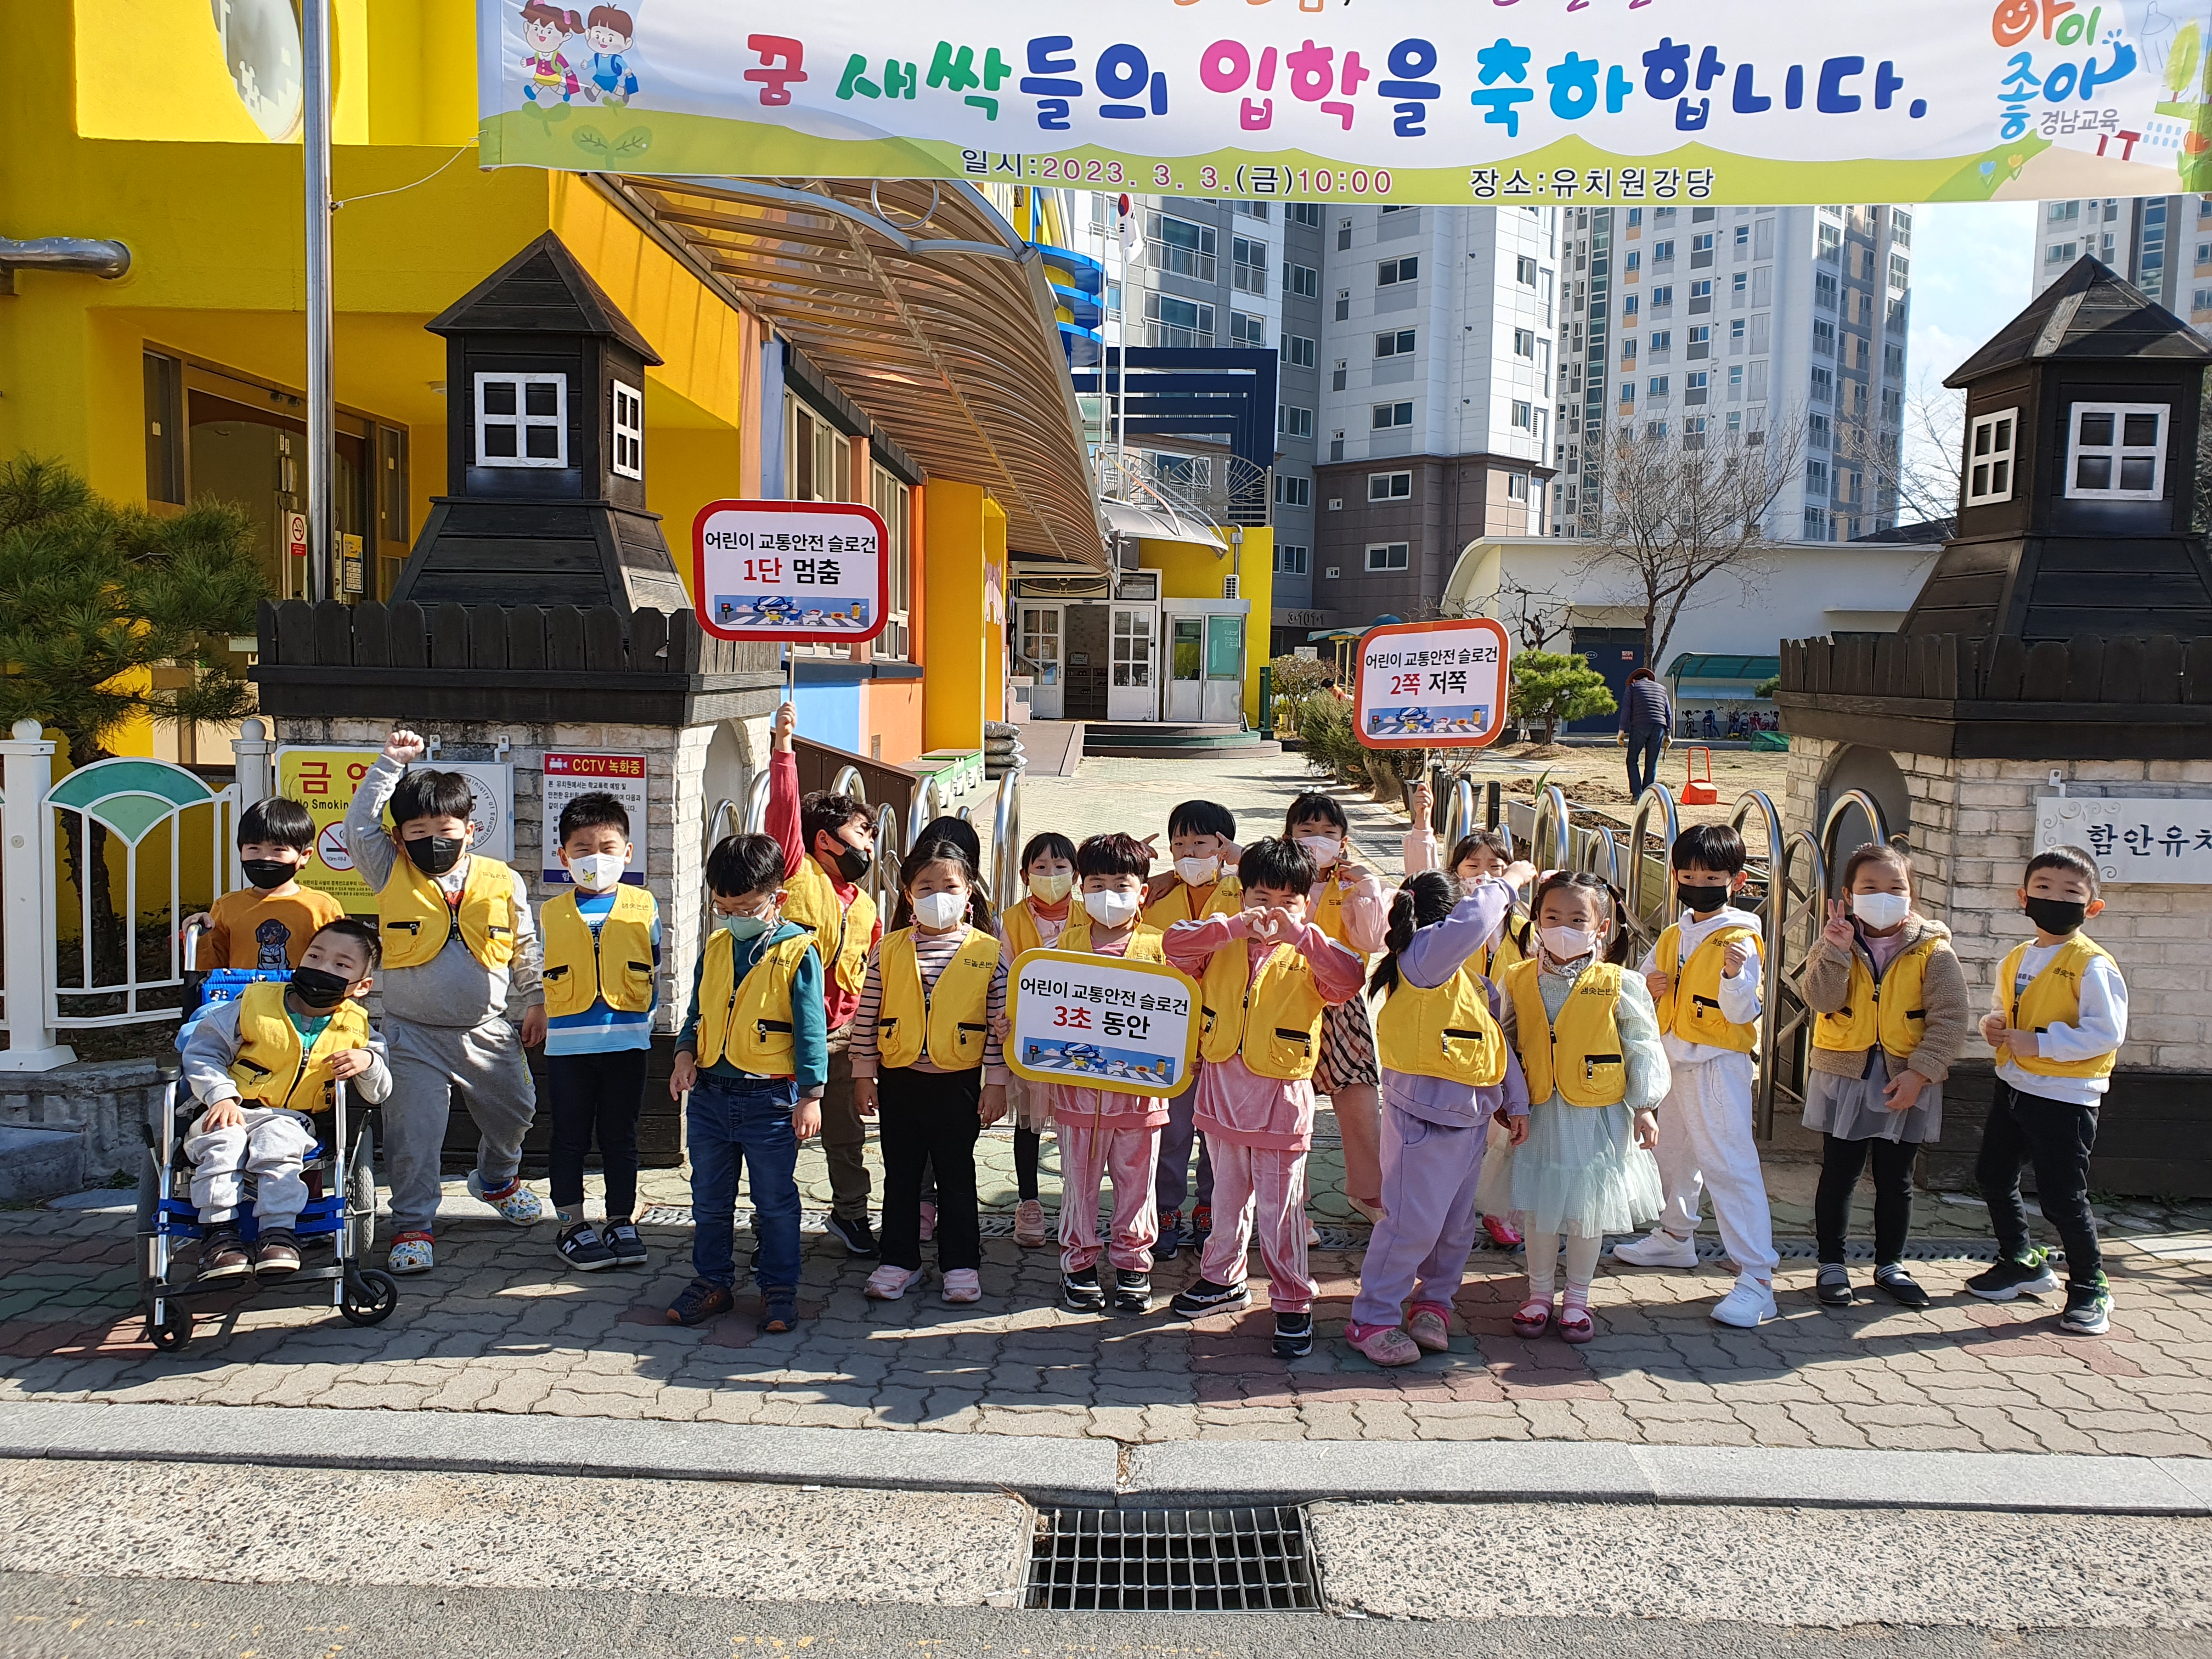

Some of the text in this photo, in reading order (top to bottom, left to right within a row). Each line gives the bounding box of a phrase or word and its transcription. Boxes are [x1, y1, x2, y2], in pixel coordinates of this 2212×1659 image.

[743, 33, 1928, 138] 꿈 새싹들의 입학을 축하합니다.
[1997, 41, 2138, 140] 좋아
[2040, 108, 2120, 136] 경남교육
[962, 149, 1137, 187] 일시:2023.
[1154, 163, 1183, 190] 3.
[1468, 166, 1715, 199] 장소:유치원강당
[705, 531, 876, 554] 어린이 교통안전 슬로건
[743, 557, 842, 585] 1단 멈춤
[1365, 646, 1498, 669] 어린이 교통안전 슬로건
[1390, 670, 1468, 696] 2쪽 저쪽
[298, 761, 332, 794] 금
[572, 758, 641, 775] CCTV 녹화중
[1020, 978, 1188, 1016] 어린이 교통안전 슬로건
[1580, 986, 1614, 996] 샘솟는반
[1052, 1005, 1150, 1040] 3초 동안
